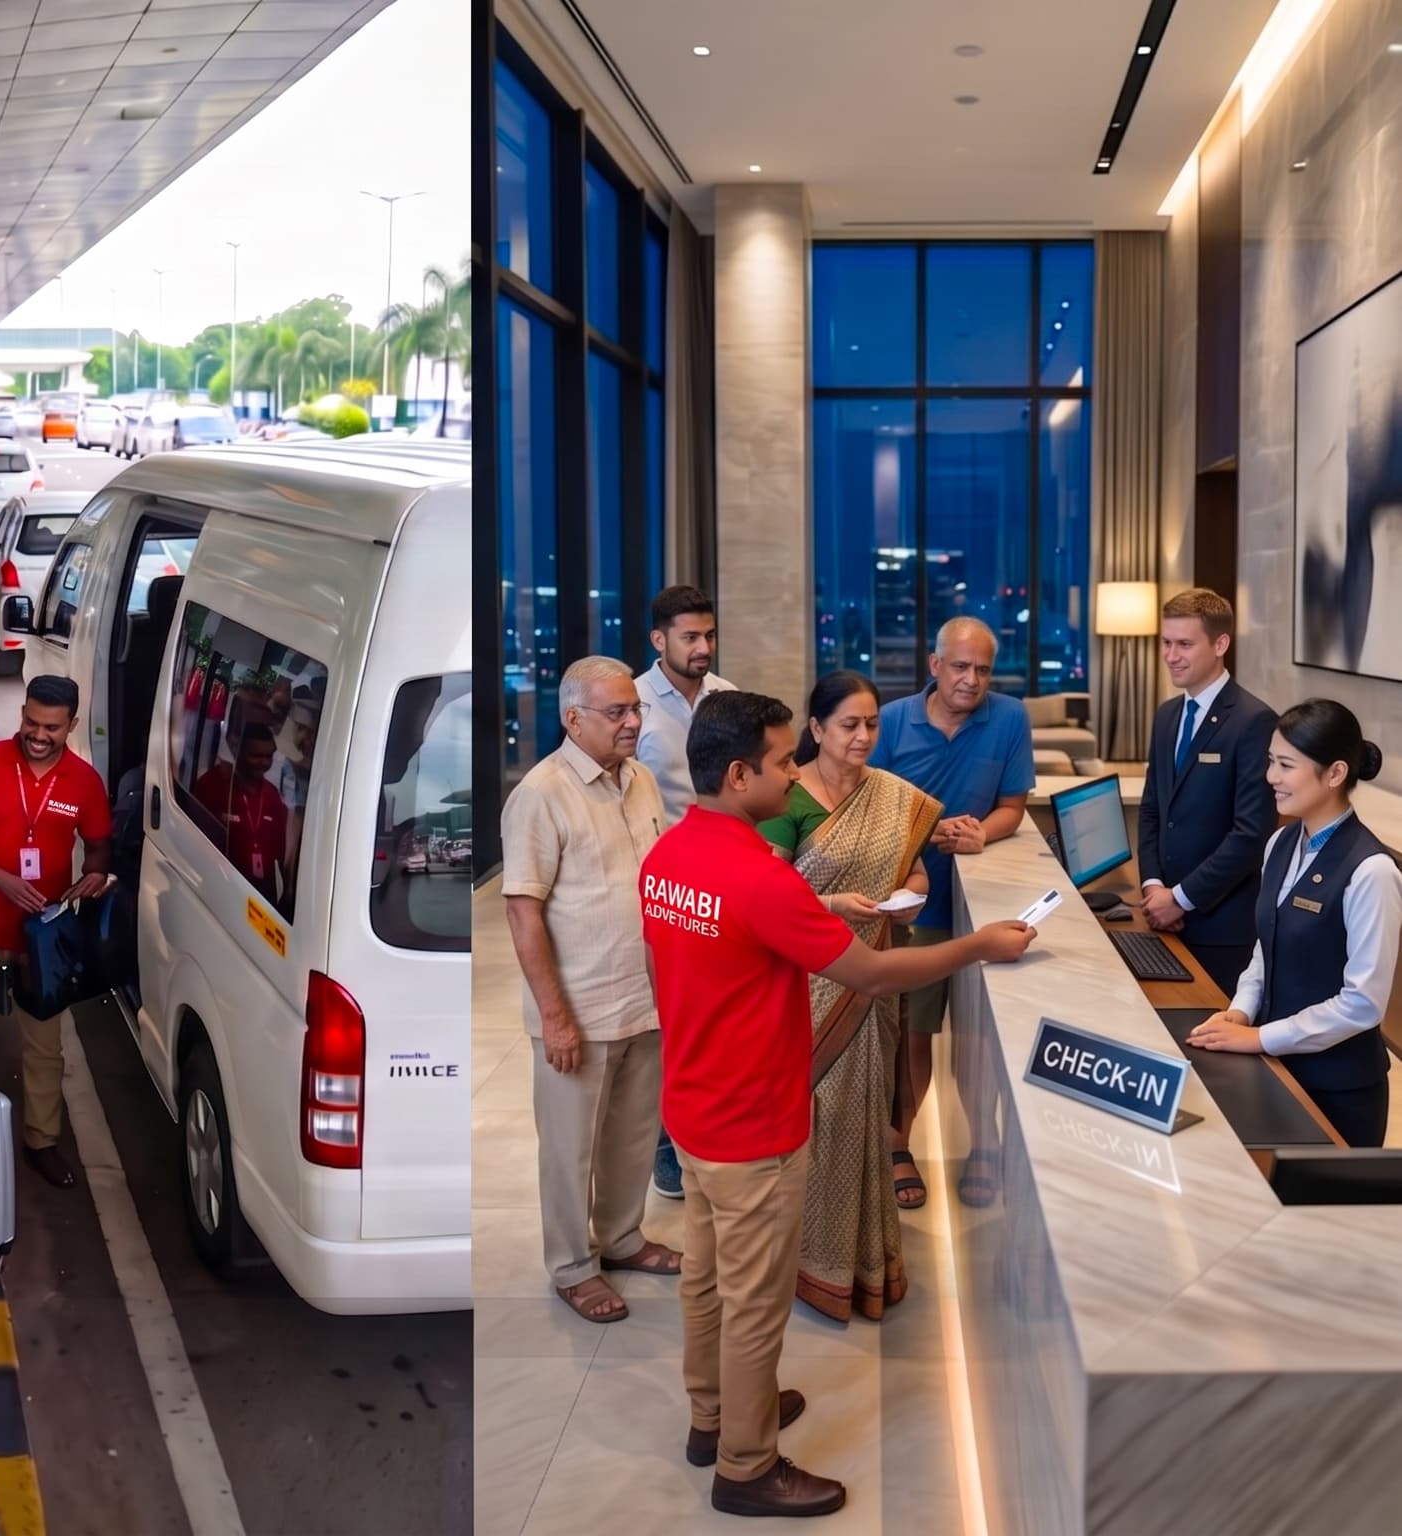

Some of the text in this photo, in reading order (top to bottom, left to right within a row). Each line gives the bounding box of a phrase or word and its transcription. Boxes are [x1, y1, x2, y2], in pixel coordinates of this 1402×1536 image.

[644, 874, 721, 921] RAWABI
[644, 902, 720, 938] ADVETURES
[1043, 1041, 1168, 1107] CHECK-IN
